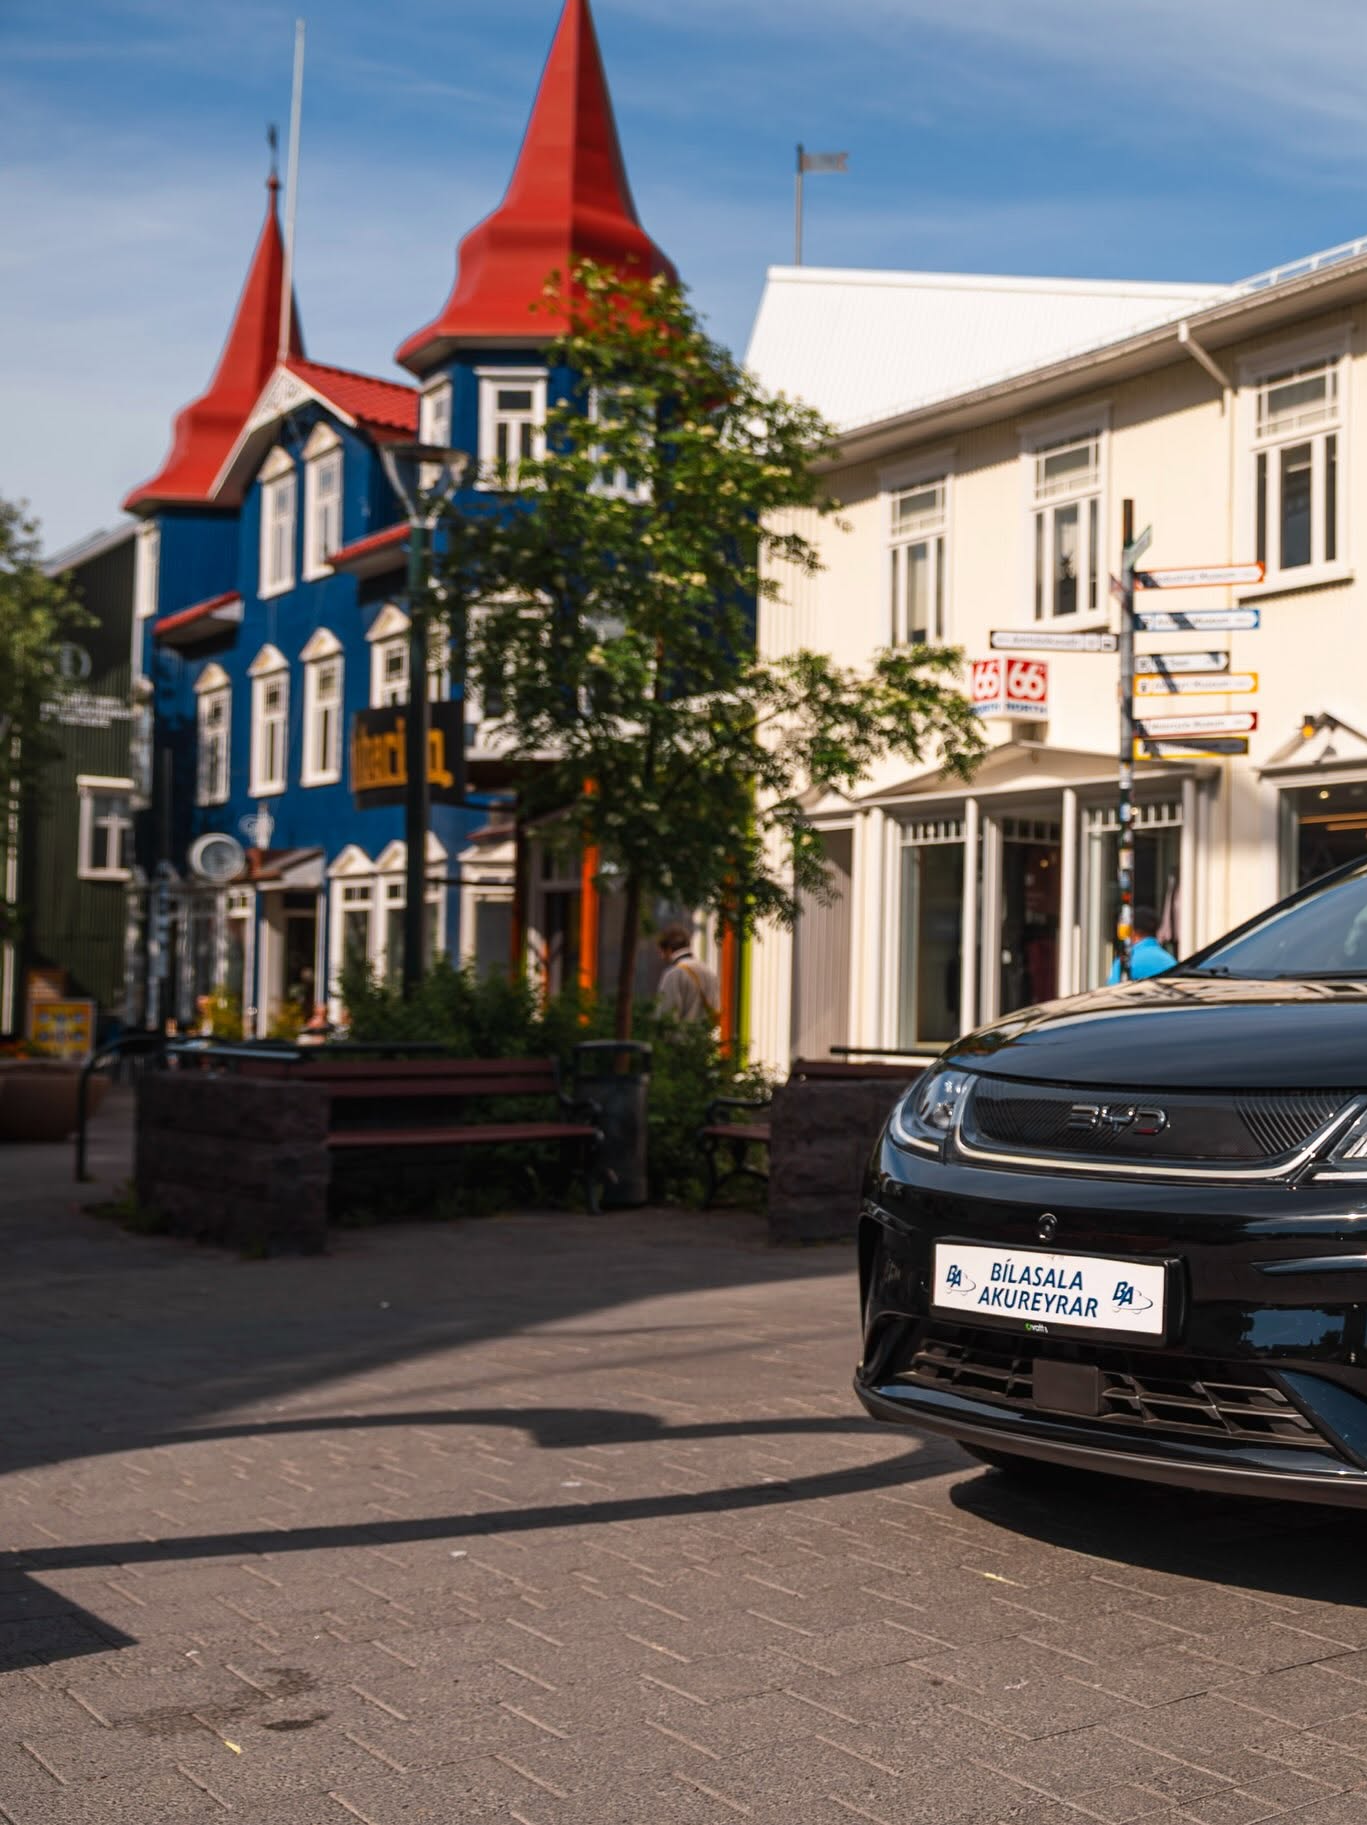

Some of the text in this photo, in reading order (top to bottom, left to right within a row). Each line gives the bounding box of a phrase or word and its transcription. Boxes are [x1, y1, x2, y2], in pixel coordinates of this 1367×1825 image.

[1069, 1104, 1166, 1134] BYD
[990, 1258, 1083, 1291] BÍLASALA
[978, 1286, 1099, 1318] AKUREYRAR
